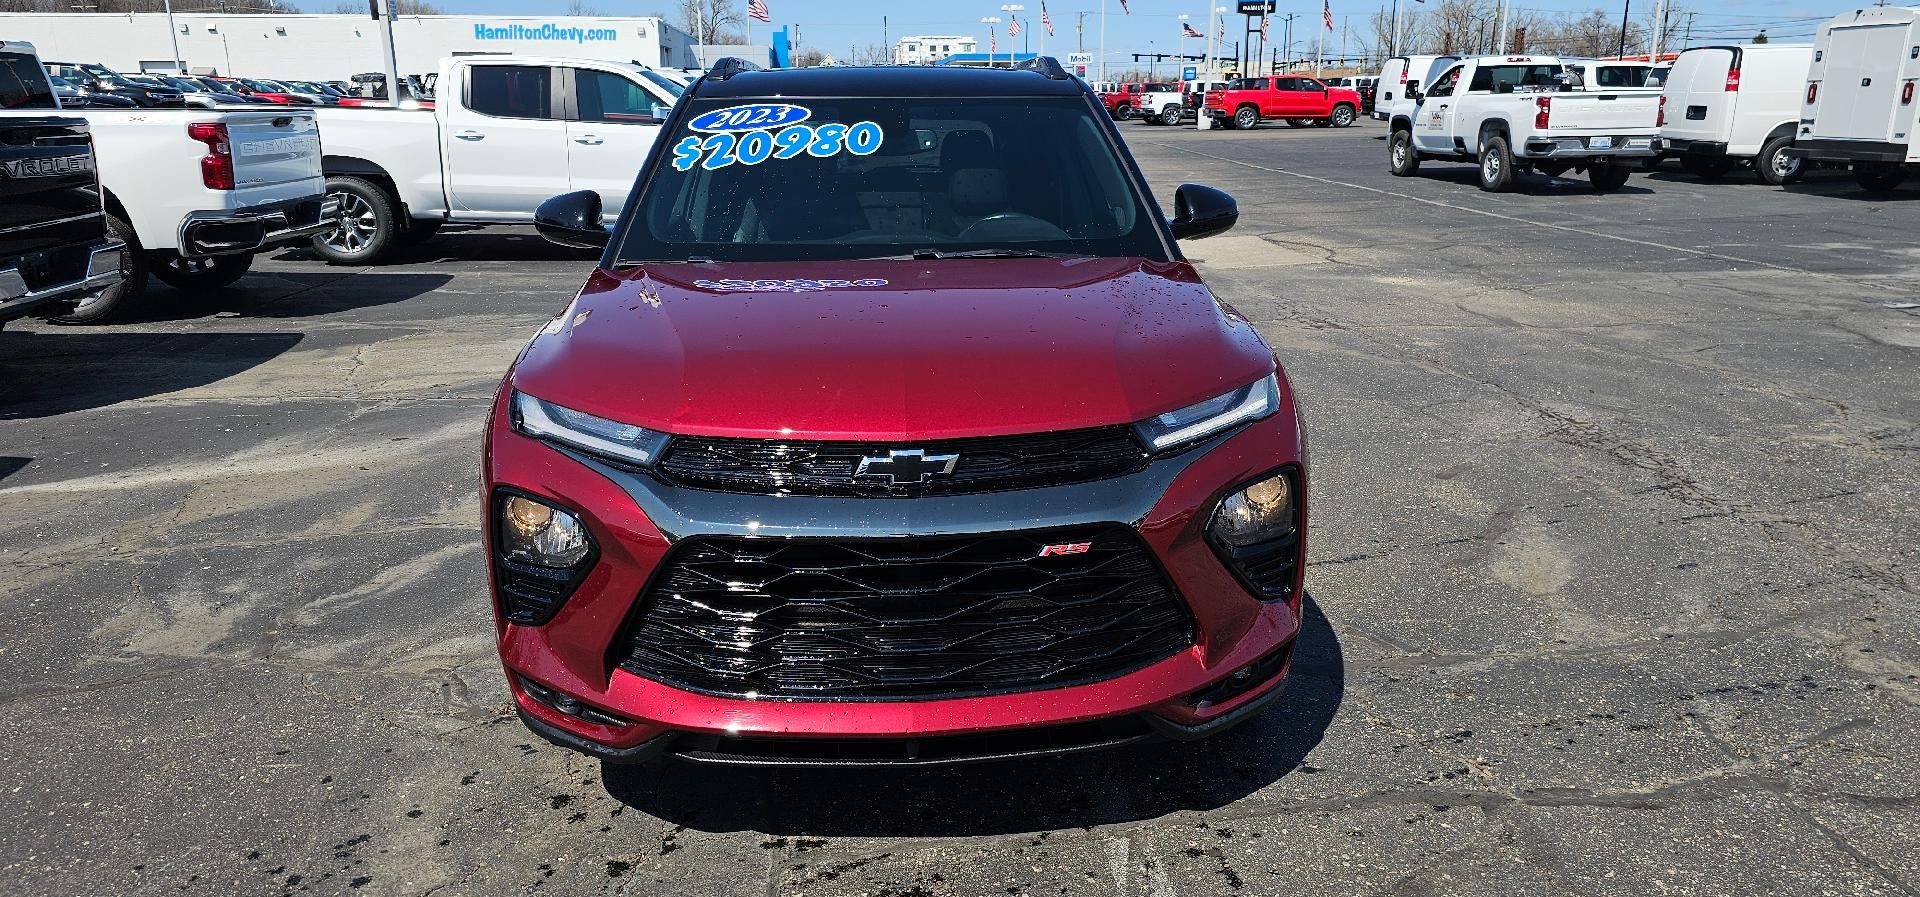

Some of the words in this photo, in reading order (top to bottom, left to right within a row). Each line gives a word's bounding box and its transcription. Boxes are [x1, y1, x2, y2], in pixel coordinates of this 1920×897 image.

[474, 23, 617, 44] HamiltonChevy.com
[1070, 55, 1091, 63] Mobil
[705, 106, 792, 129] 2023
[672, 120, 884, 172] $20980
[0, 157, 89, 178] VROLET
[1038, 541, 1092, 557] RS
